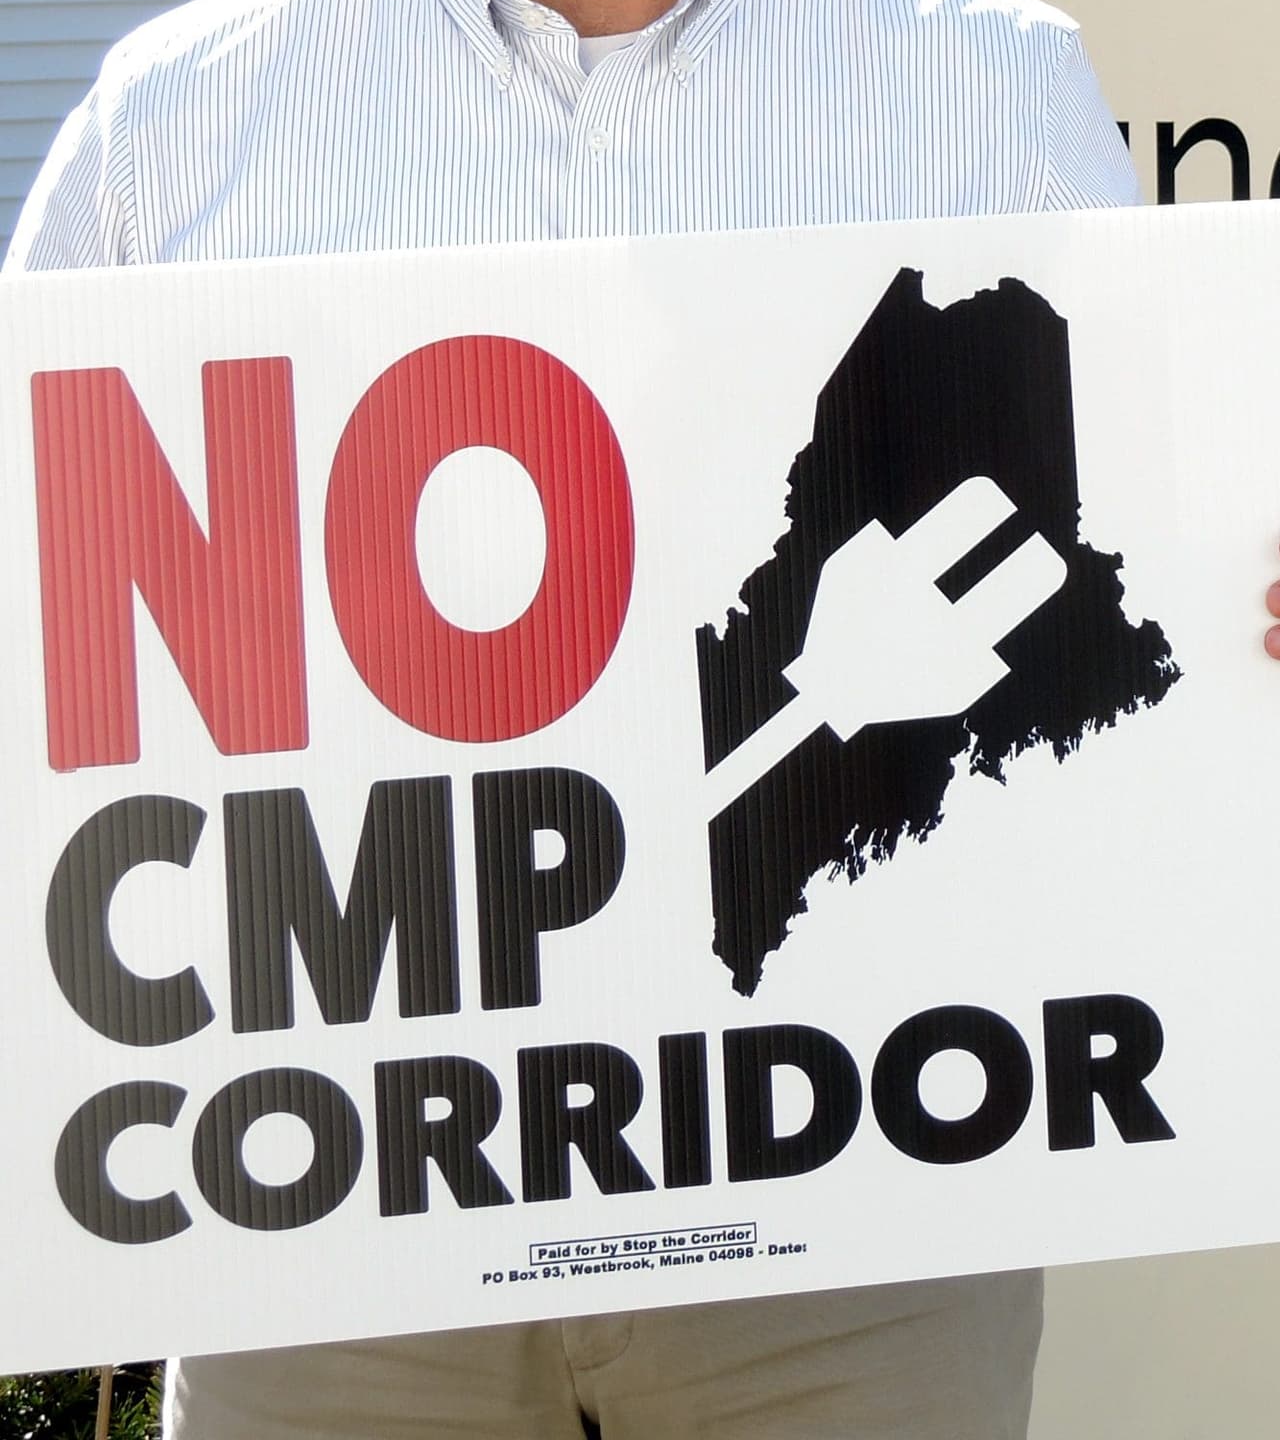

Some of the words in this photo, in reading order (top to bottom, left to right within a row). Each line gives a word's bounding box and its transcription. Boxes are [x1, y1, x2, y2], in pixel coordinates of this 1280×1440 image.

[31, 334, 636, 771] NO
[45, 766, 627, 1047] CMP
[54, 993, 1177, 1245] CORRIDOR
[538, 1246, 571, 1260] Paid
[575, 1244, 597, 1257] for
[601, 1242, 619, 1257] by
[623, 1239, 657, 1252] Stop
[662, 1236, 686, 1248] the
[691, 1229, 752, 1245] Corridor
[482, 1272, 503, 1284] PO
[509, 1269, 538, 1282] Box
[542, 1266, 565, 1279] 93,
[570, 1257, 655, 1275] Westbrook,
[660, 1254, 704, 1267] Maine
[709, 1247, 754, 1261] 04098
[768, 1243, 807, 1256] Date:
